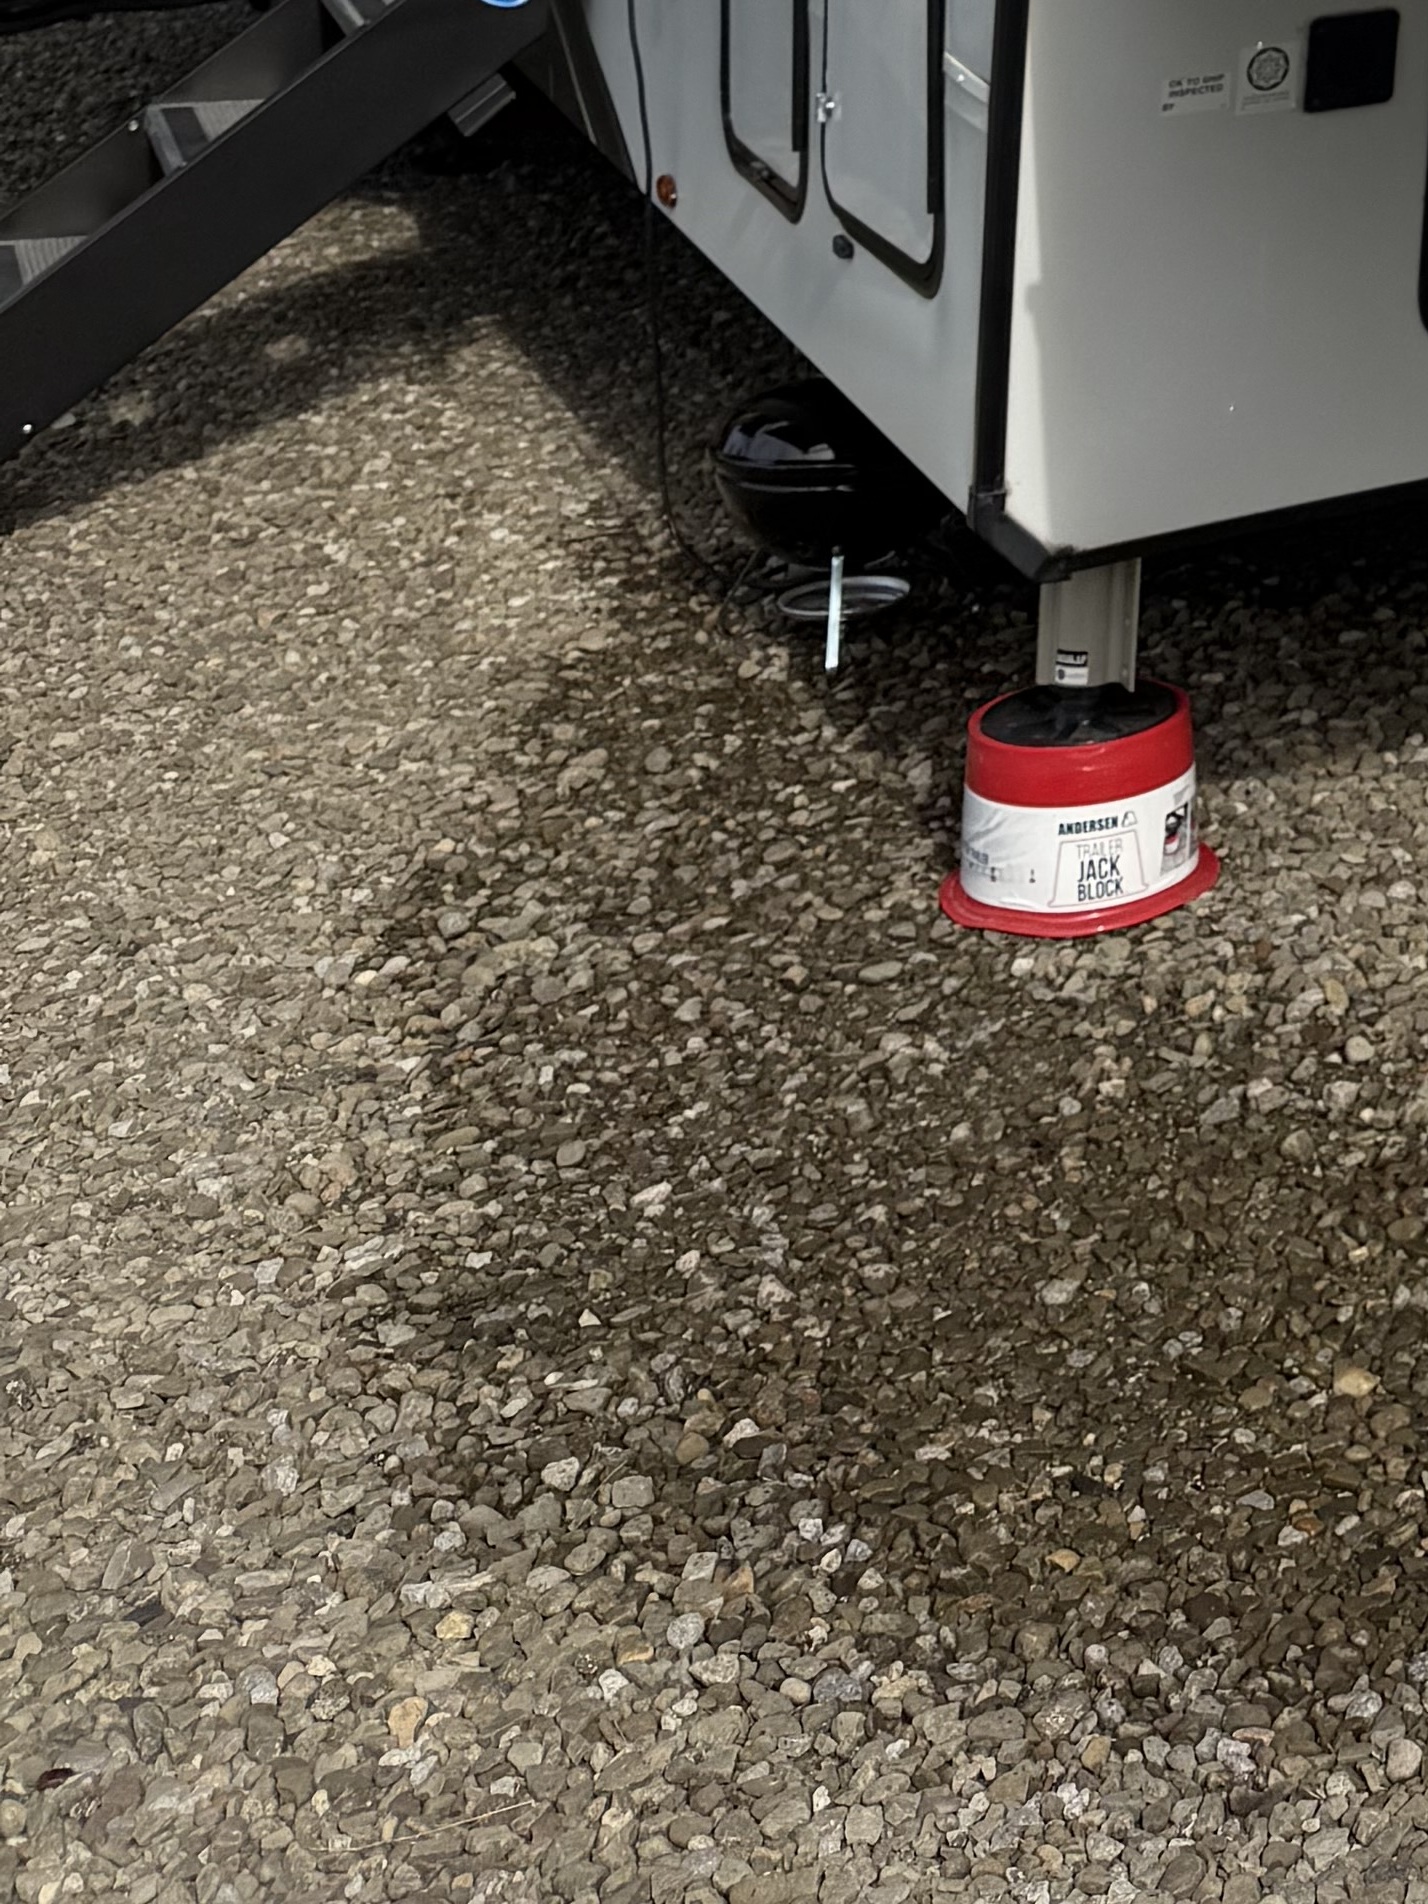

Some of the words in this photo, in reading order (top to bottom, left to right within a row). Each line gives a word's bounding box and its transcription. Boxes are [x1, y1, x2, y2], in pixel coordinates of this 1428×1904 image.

[1058, 815, 1119, 836] ANDERSEN
[1076, 838, 1123, 860] TRAILER
[1077, 854, 1121, 883] JACK
[1077, 876, 1124, 902] BLOCK
